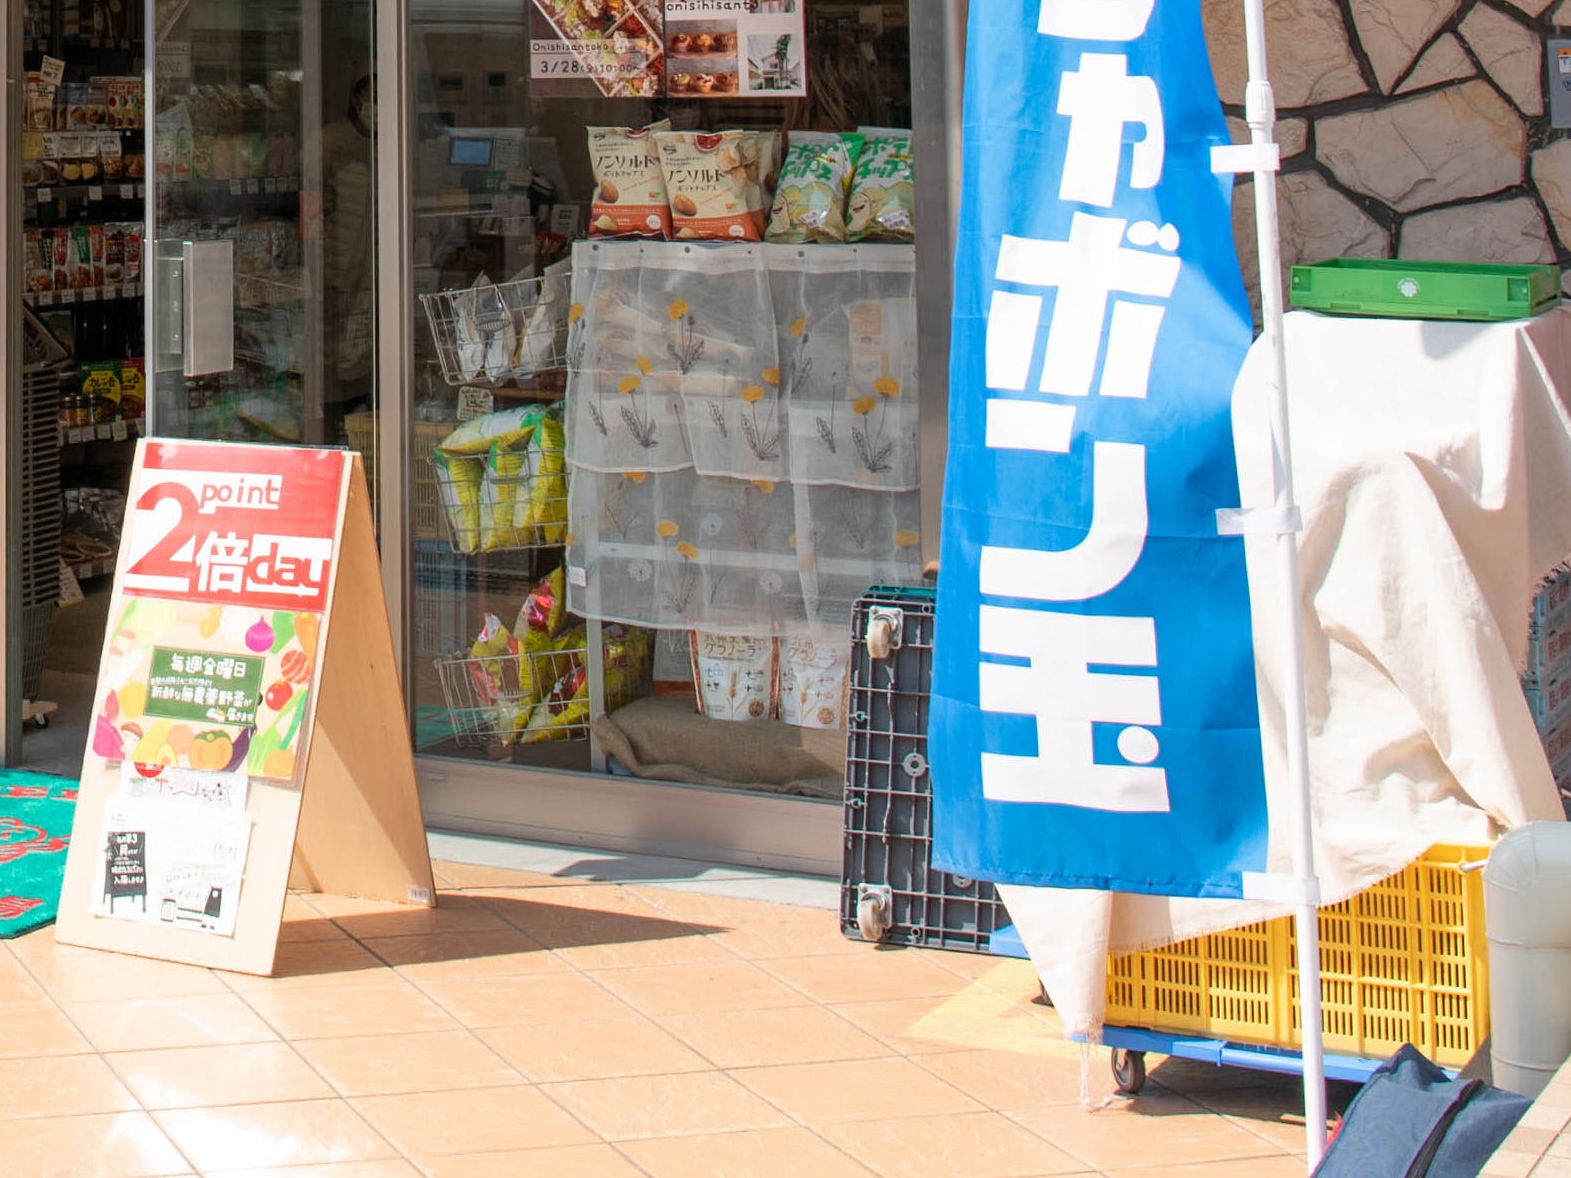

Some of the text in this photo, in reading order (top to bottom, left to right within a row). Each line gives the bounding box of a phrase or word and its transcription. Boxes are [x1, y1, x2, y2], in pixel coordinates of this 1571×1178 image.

[199, 478, 279, 509] point
[705, 642, 757, 657] グラノーラ
[171, 653, 246, 679] 毎週金曜日
